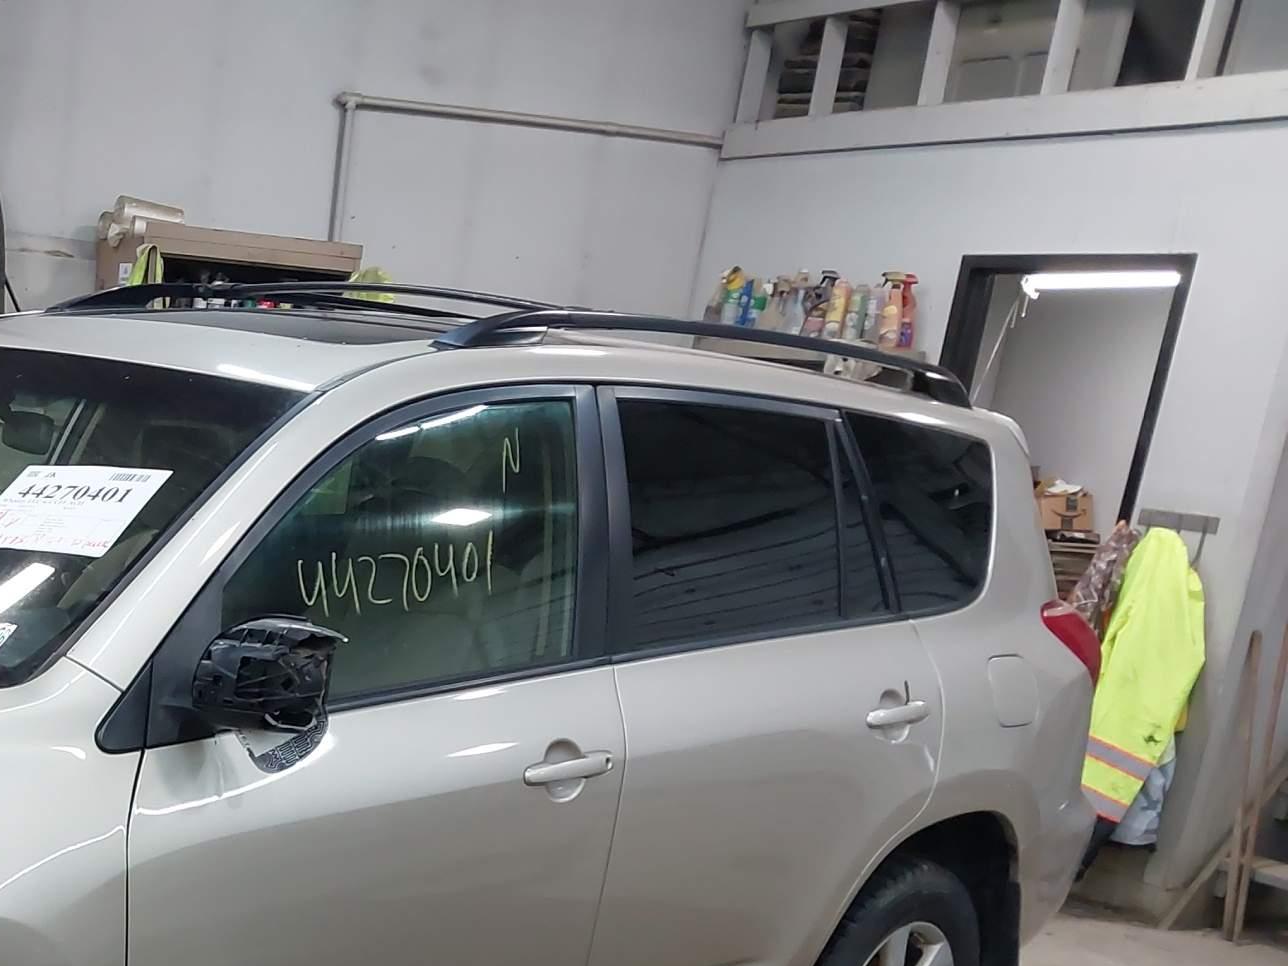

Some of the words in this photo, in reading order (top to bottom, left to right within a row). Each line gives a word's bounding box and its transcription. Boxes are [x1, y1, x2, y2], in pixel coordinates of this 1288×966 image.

[18, 483, 133, 504] 44270401
[501, 427, 521, 494] N
[297, 529, 494, 618] 44270401
